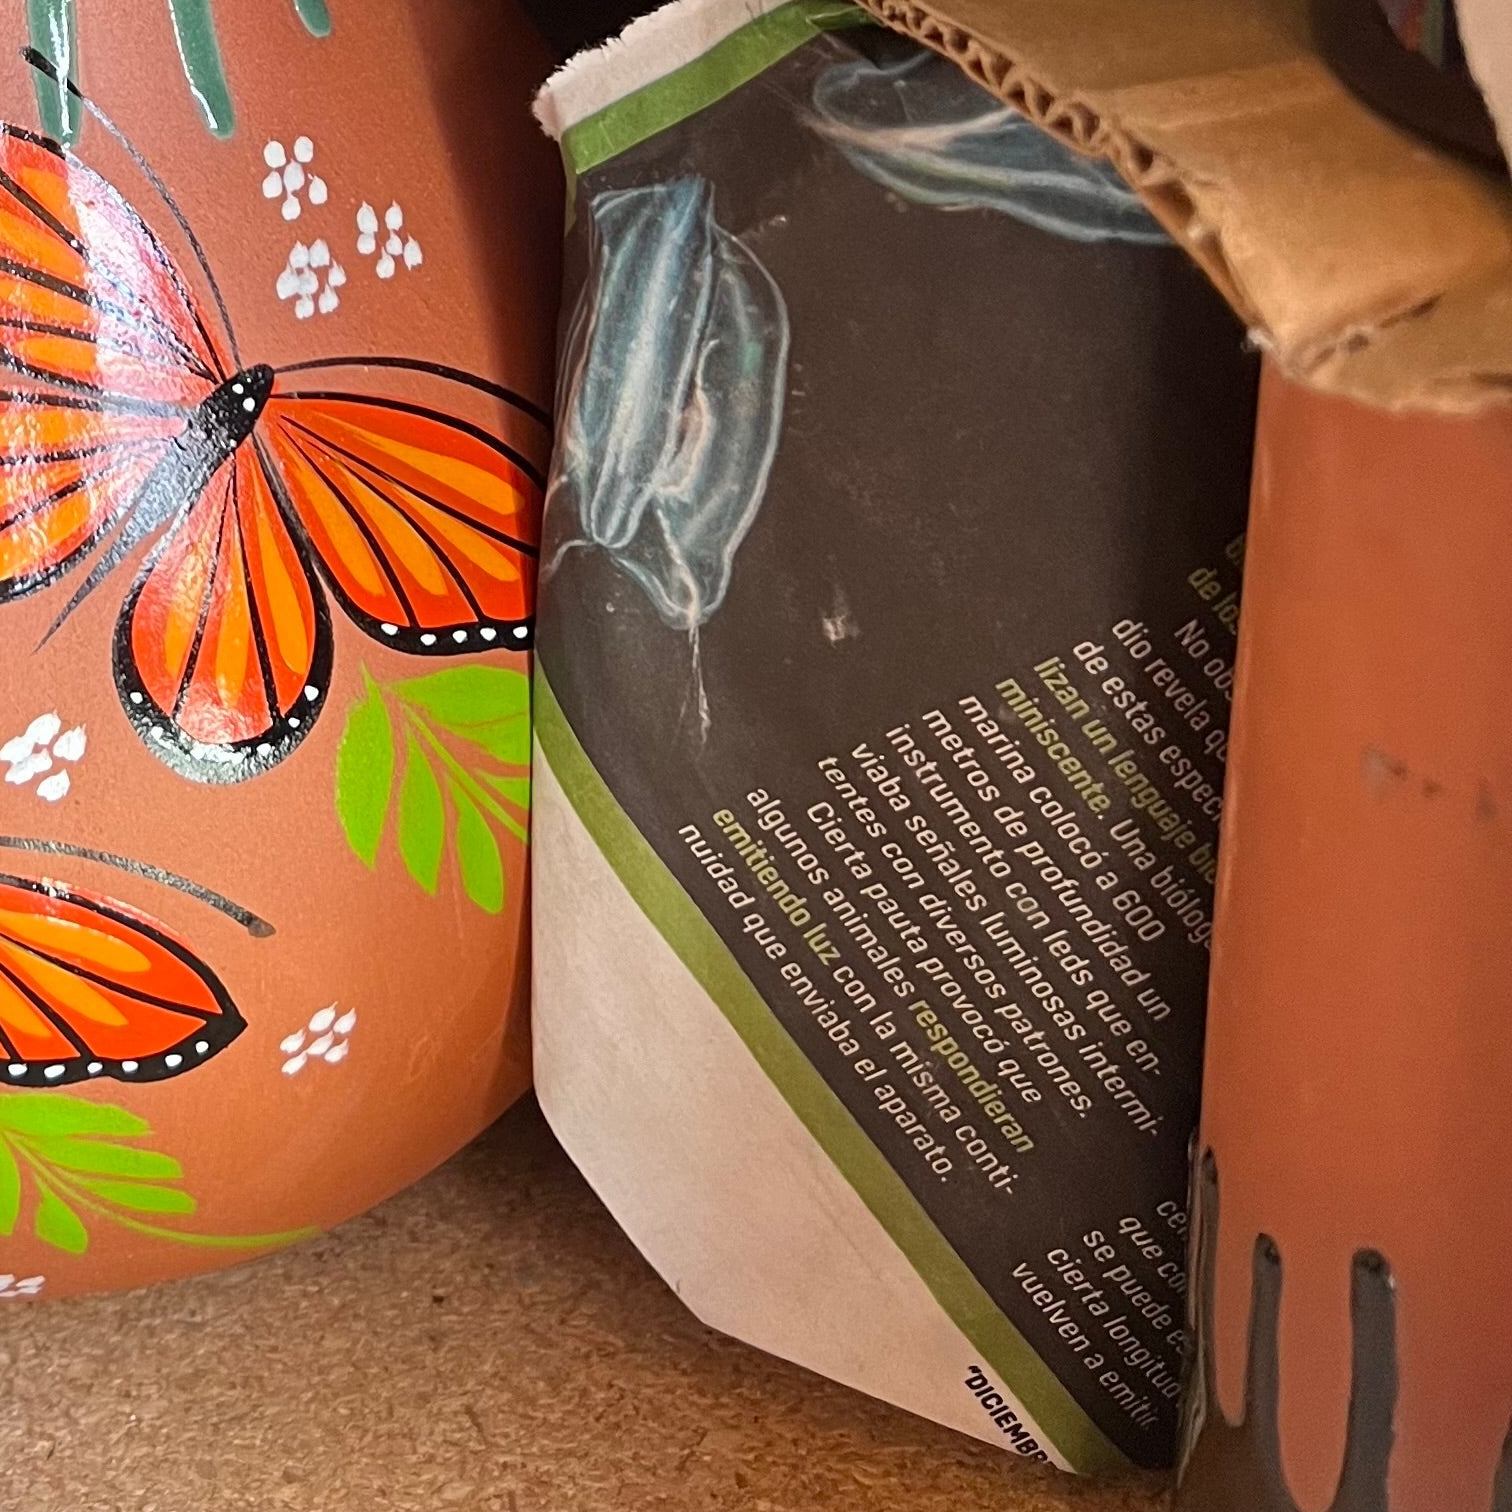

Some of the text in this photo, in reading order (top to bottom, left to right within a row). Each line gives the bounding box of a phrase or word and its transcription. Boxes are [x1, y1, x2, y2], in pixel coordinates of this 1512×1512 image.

[1072, 641, 1109, 675] de
[1101, 676, 1165, 745] estas
[1111, 619, 1152, 659] dio
[1143, 658, 1210, 732] revela
[1174, 619, 1210, 659] No
[1187, 568, 1221, 601] de
[922, 710, 1171, 1021] metros de profundidad un
[958, 696, 1165, 942] marina colocó a 600
[995, 678, 1213, 949] miniscente. Una biólog
[1033, 656, 1090, 720] lizan
[1081, 719, 1117, 755] un
[1107, 749, 1195, 849] lenguaje
[678, 824, 953, 1183] nuidad que enviaba el aparato.
[712, 809, 1018, 1195] emitiendo luz con la misma conti-
[746, 789, 1034, 1153] algunos animales respondieran
[806, 802, 1042, 1103] Cierta pauta provocó que
[818, 757, 1092, 1119] tentes con diversos patrones.
[851, 743, 1162, 1135] viaba señales luminosas intermi-
[885, 724, 1160, 1075] instrumento con leds que en-
[1012, 1262, 1090, 1352] vuelven
[1083, 1353, 1104, 1370] a
[1047, 1248, 1110, 1316] cierta
[1082, 1230, 1115, 1263] se
[1101, 1264, 1172, 1330] puede
[1118, 1217, 1163, 1260] que
